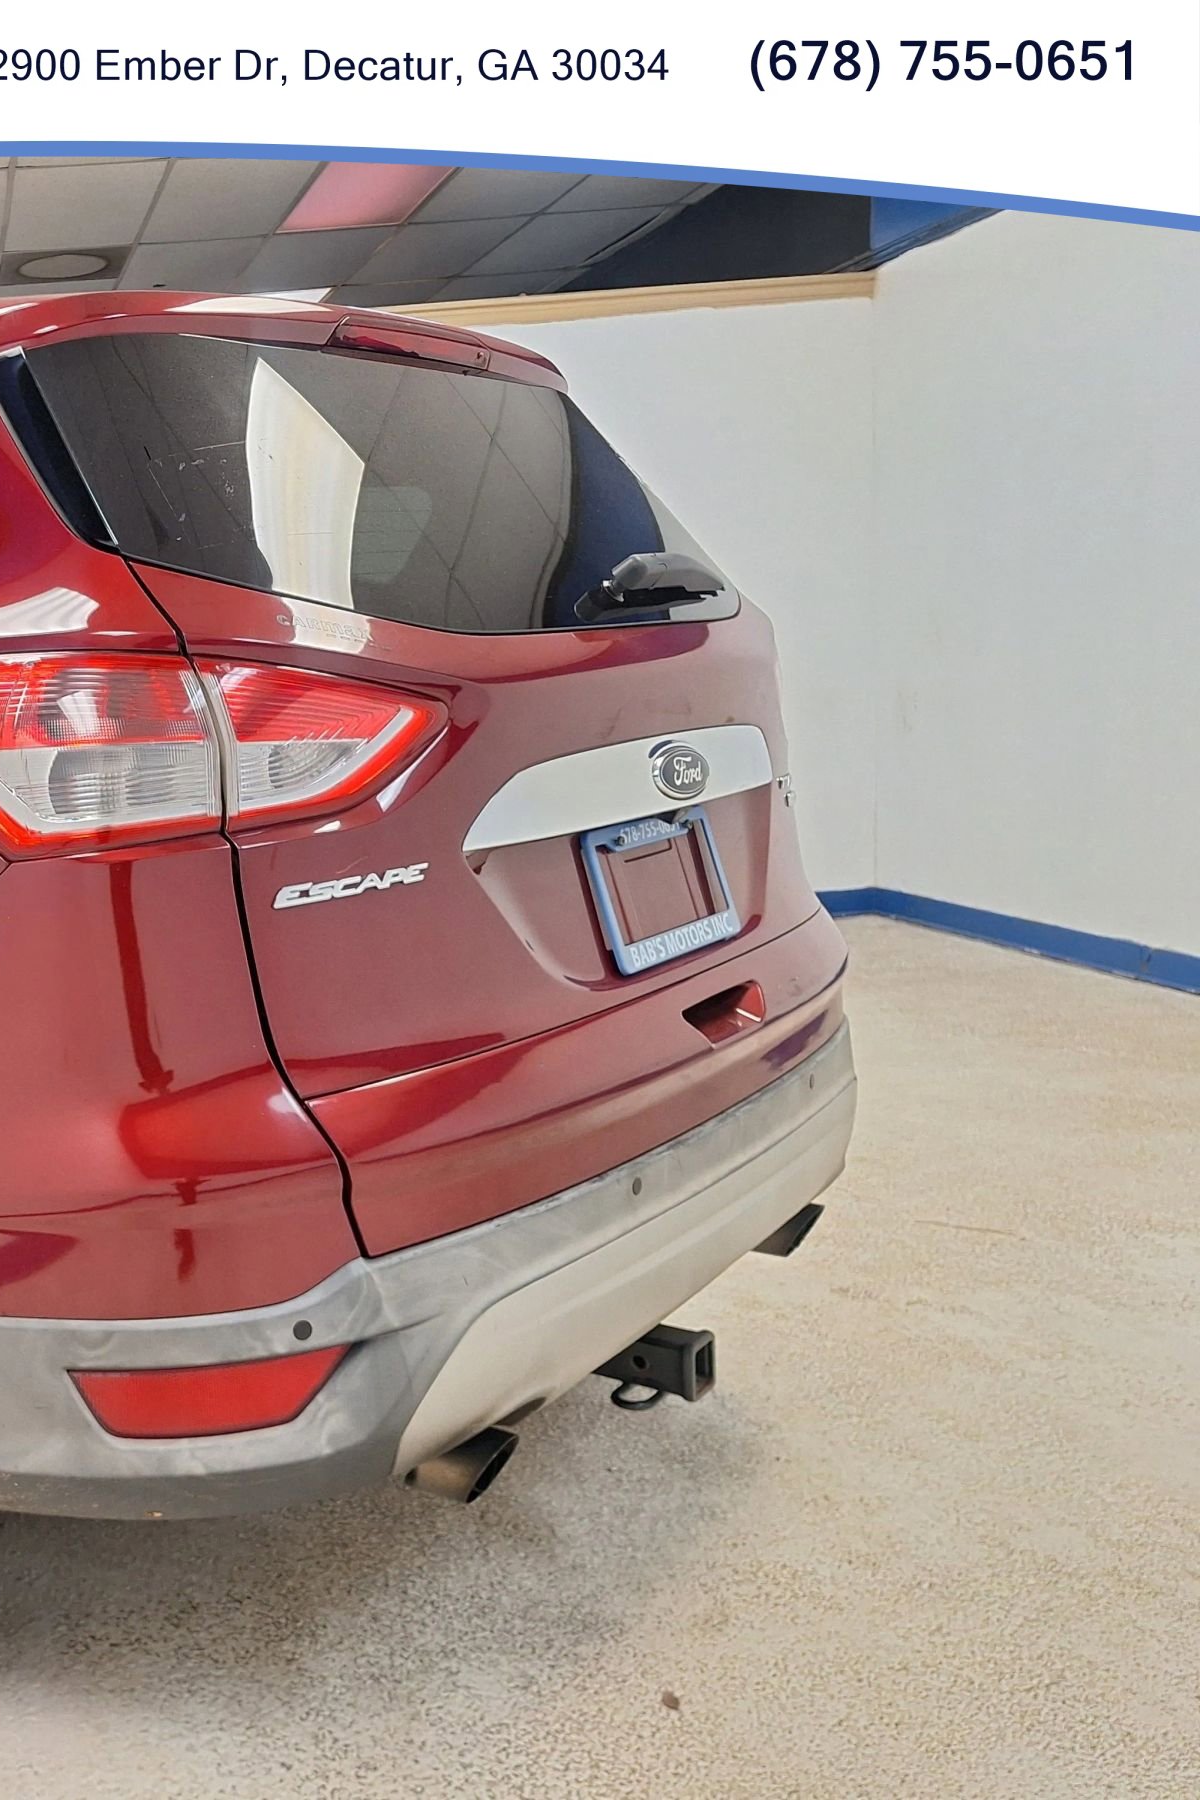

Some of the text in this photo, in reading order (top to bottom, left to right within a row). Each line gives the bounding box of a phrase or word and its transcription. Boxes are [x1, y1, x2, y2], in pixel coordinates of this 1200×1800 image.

[673, 756, 703, 786] Ford
[273, 862, 429, 909] ESCAPE
[629, 912, 734, 968] BAB'S MOTORS INC
